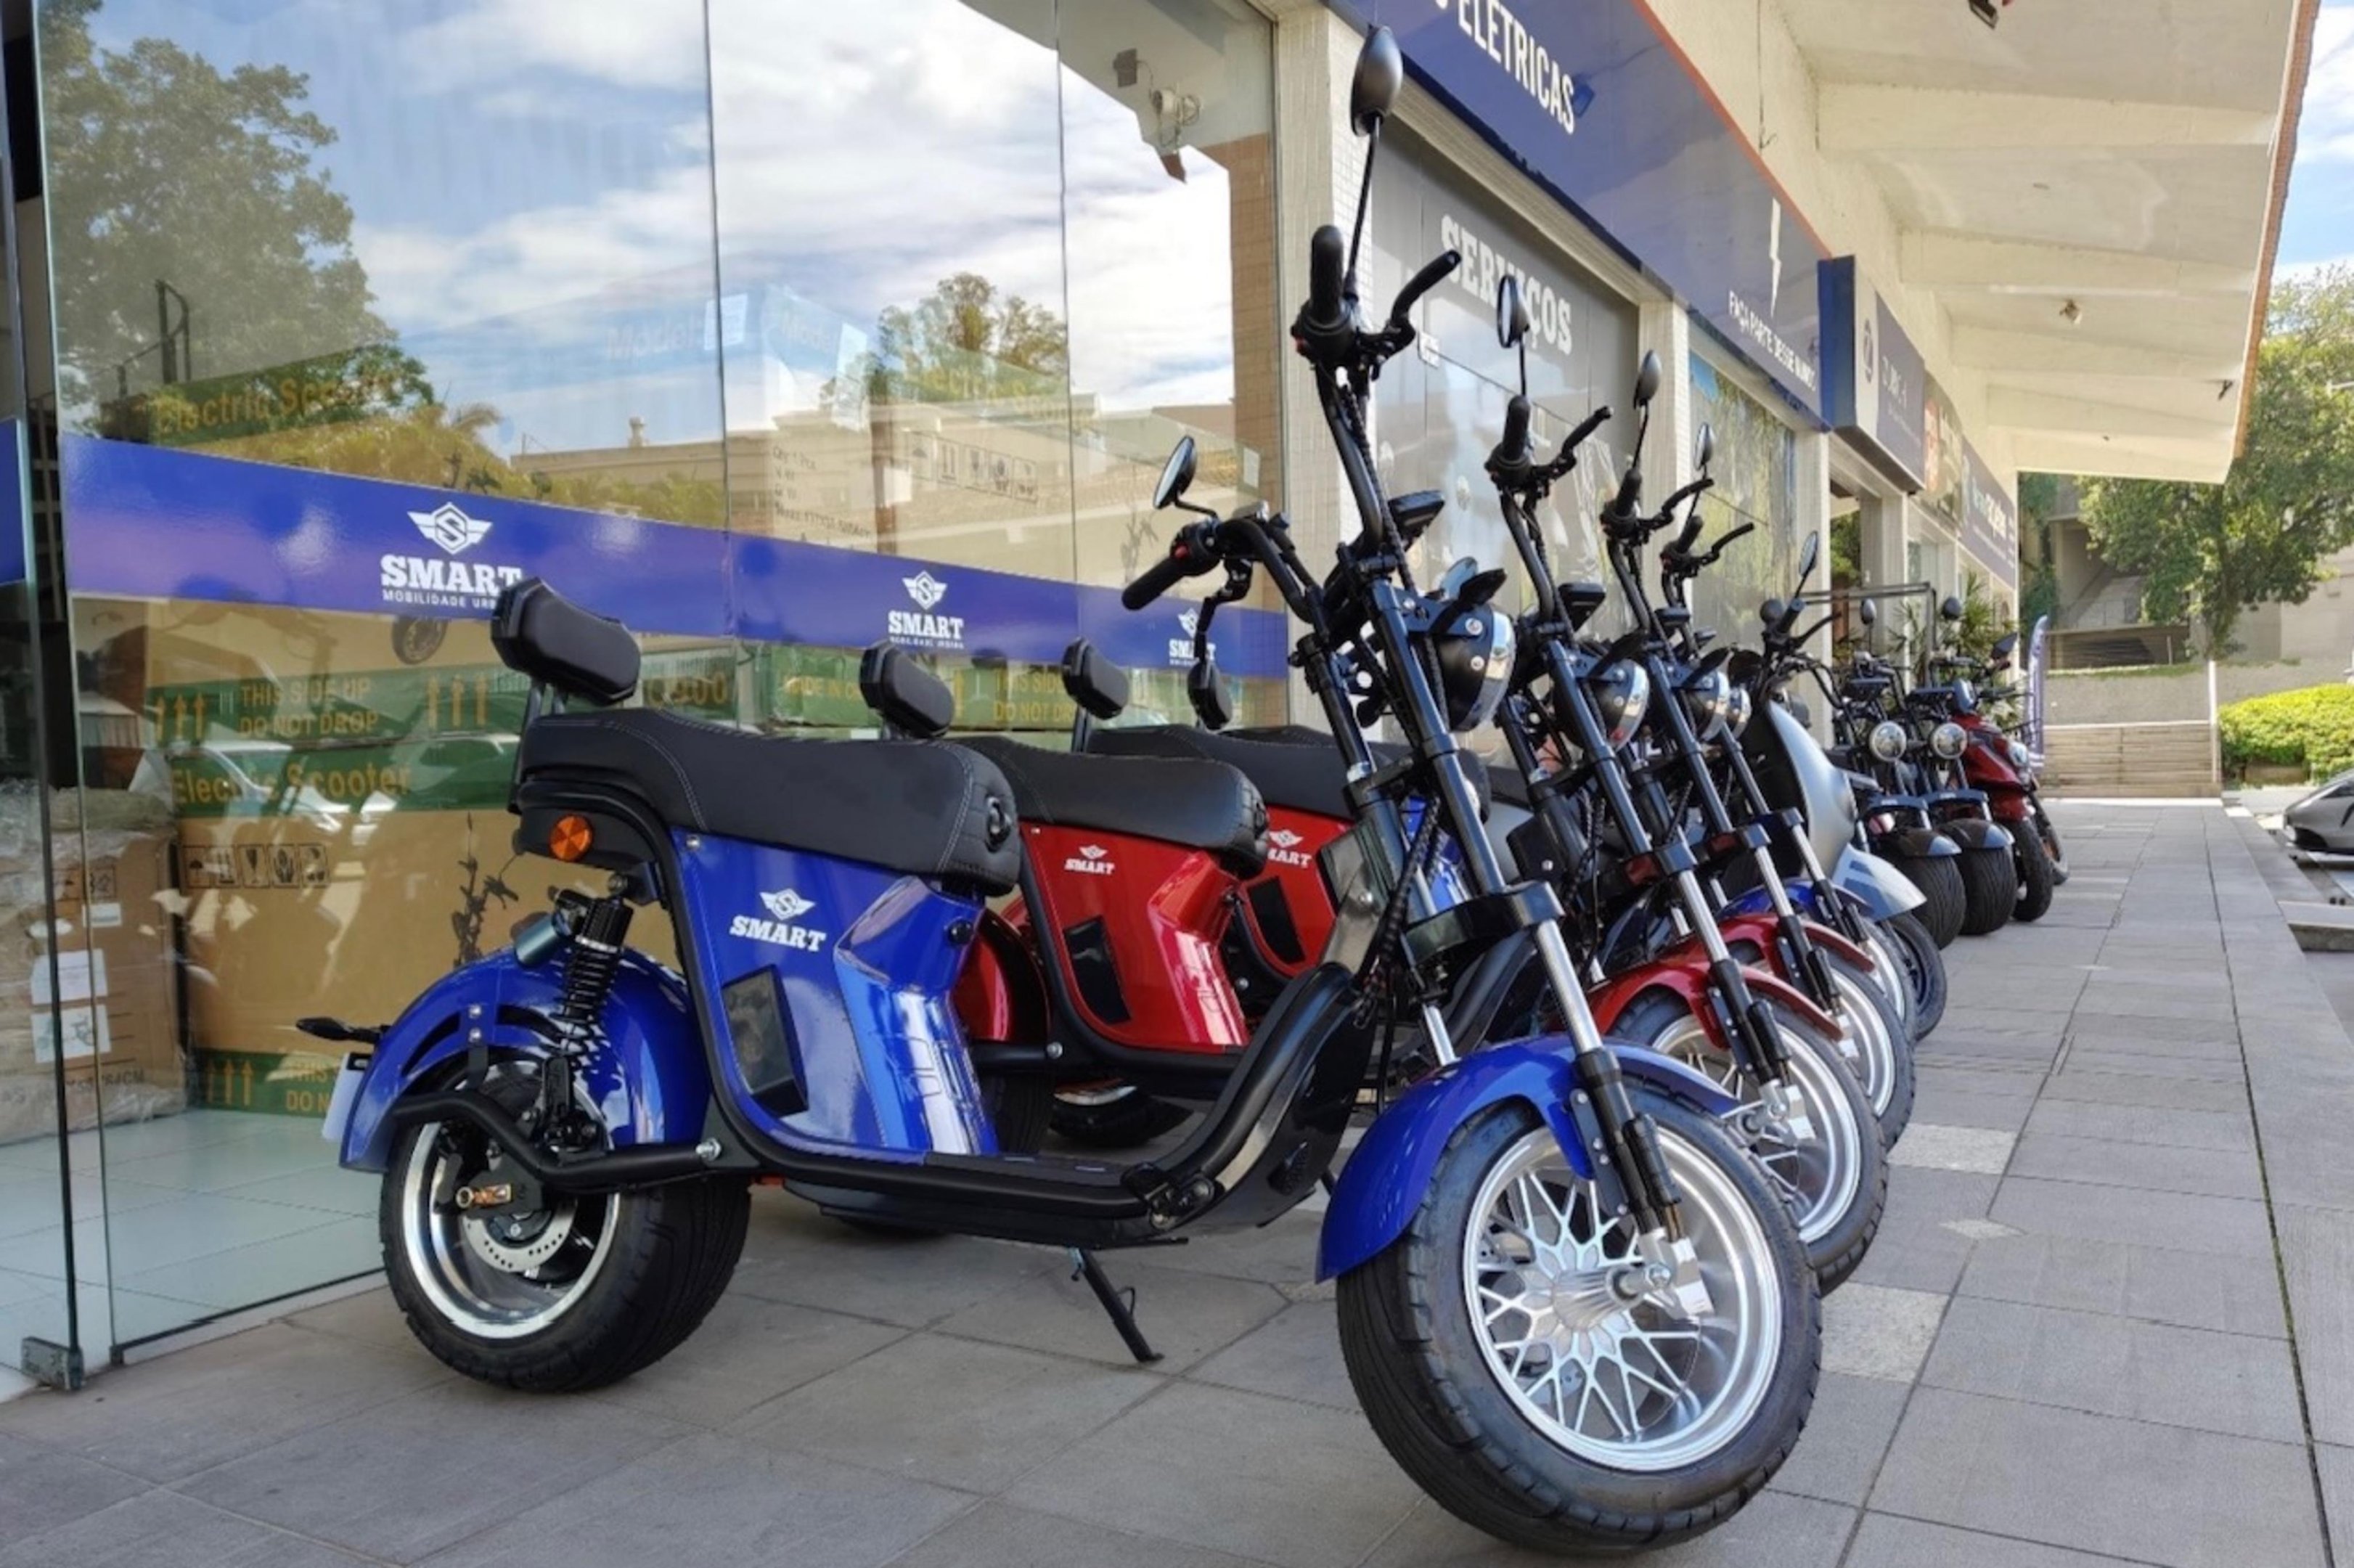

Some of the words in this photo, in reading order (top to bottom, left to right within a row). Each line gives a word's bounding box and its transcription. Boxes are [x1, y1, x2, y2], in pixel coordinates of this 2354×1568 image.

[380, 554, 522, 597] SMART
[382, 589, 466, 608] MOBILIDADE
[473, 598, 496, 609] URB
[888, 610, 964, 640] SMART
[1169, 638, 1216, 661] SMT
[1064, 857, 1115, 875] SMART
[1268, 850, 1312, 869] MART
[730, 915, 827, 952] SMART
[285, 1091, 314, 1111] DO
